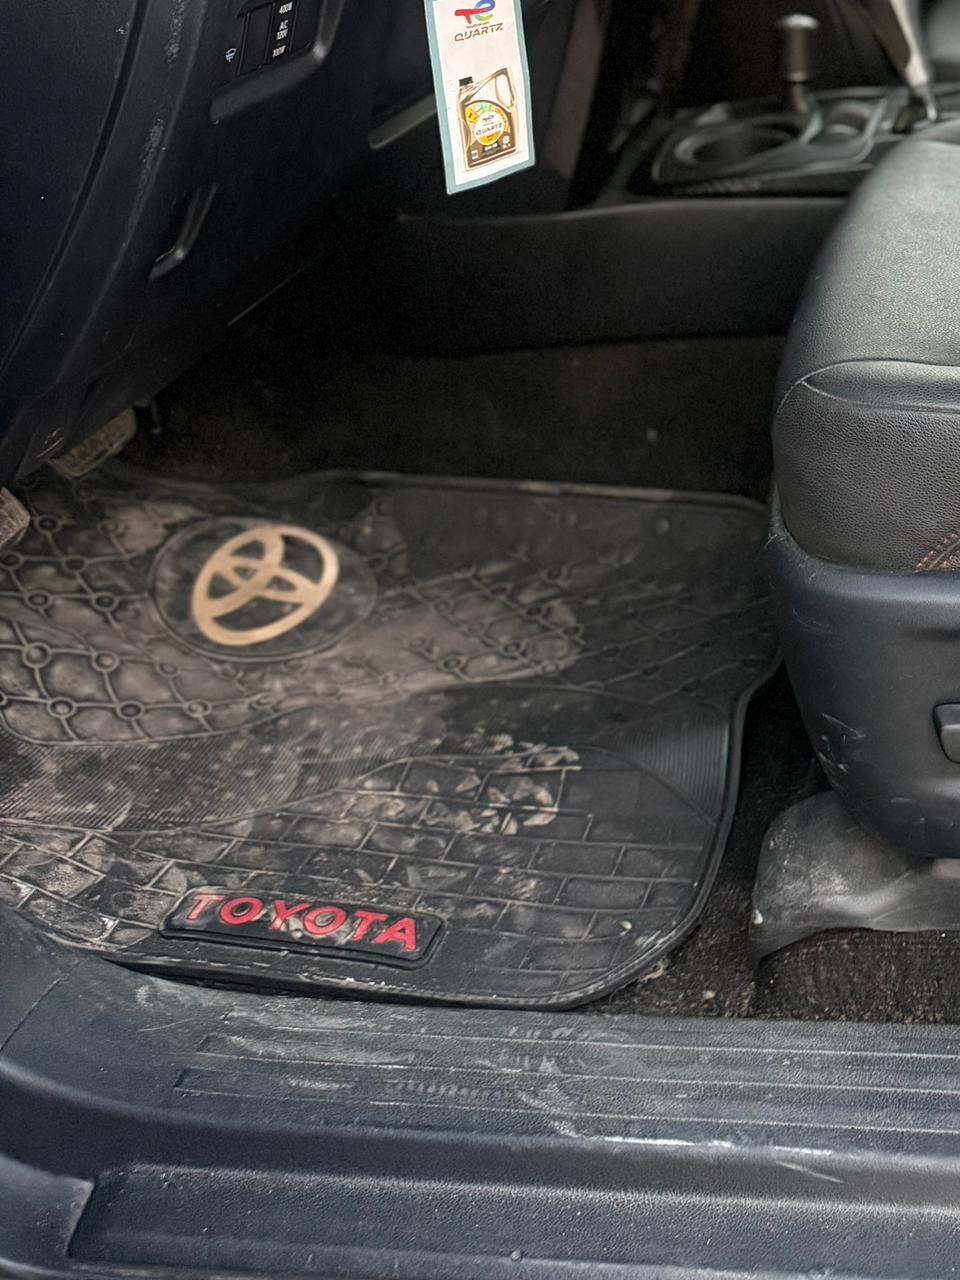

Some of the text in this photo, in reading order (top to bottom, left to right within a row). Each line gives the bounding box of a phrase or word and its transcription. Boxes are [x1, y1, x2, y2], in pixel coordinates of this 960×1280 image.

[280, 20, 288, 30] AC
[454, 22, 504, 42] QUARTZ
[186, 893, 417, 953] TOYOTA
